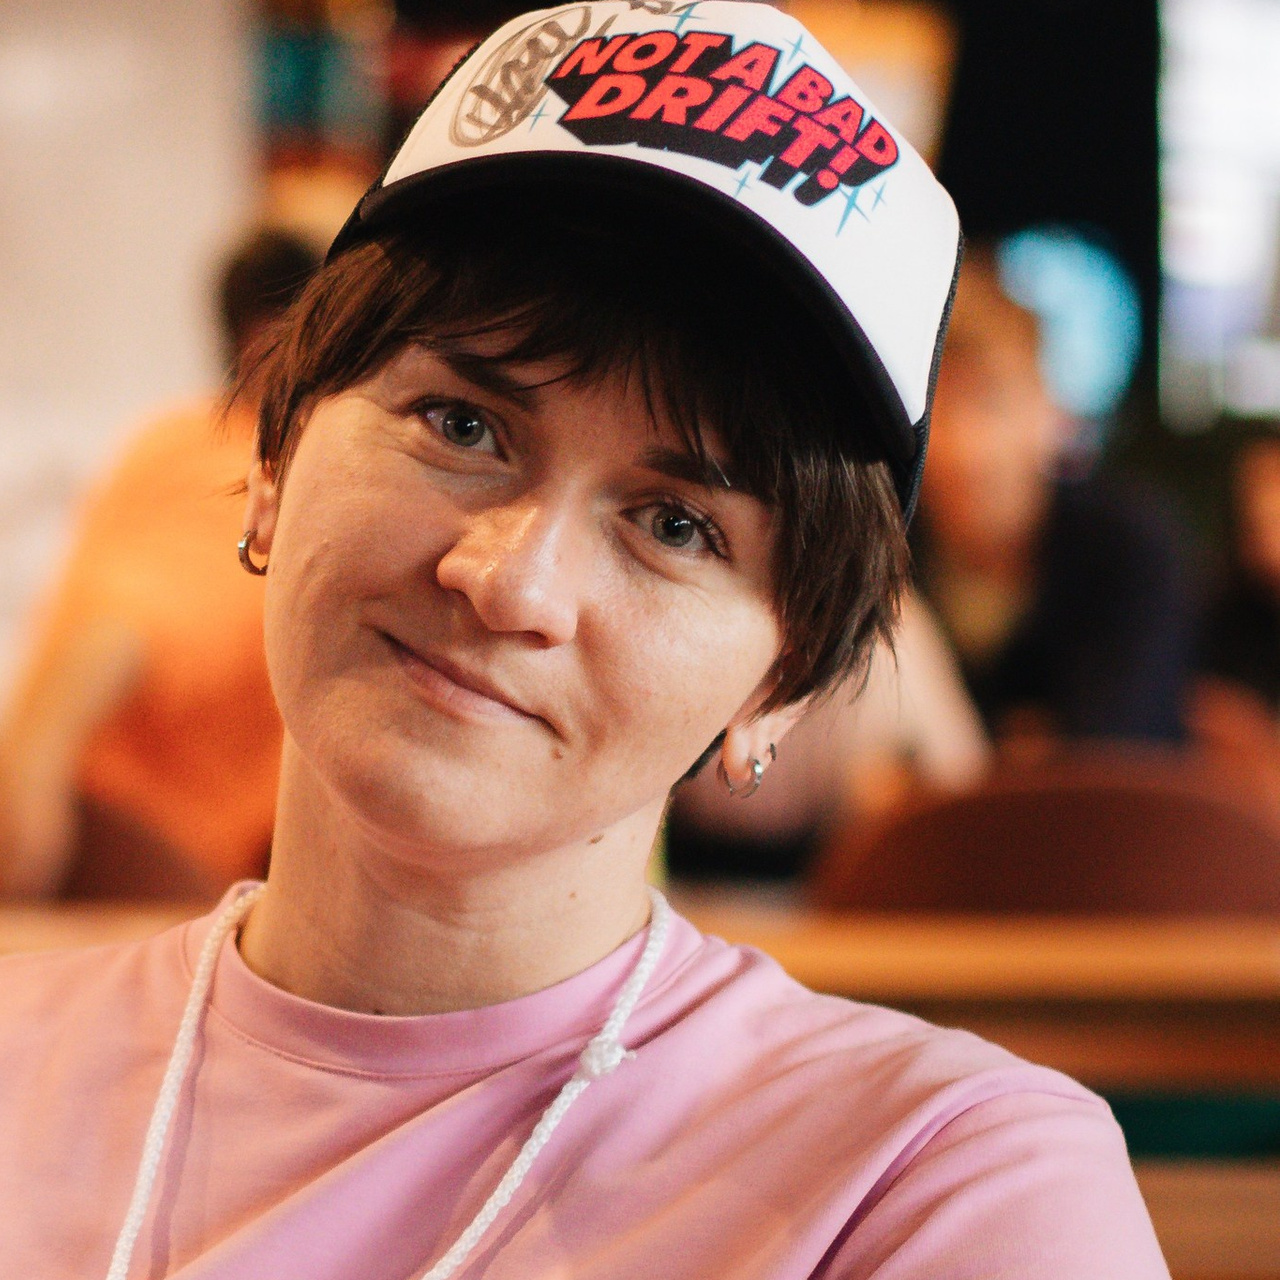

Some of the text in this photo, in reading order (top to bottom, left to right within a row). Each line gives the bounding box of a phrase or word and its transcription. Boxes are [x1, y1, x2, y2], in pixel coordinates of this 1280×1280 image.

[553, 30, 900, 169] NOT A BAD
[562, 73, 861, 191] DRIFT!
